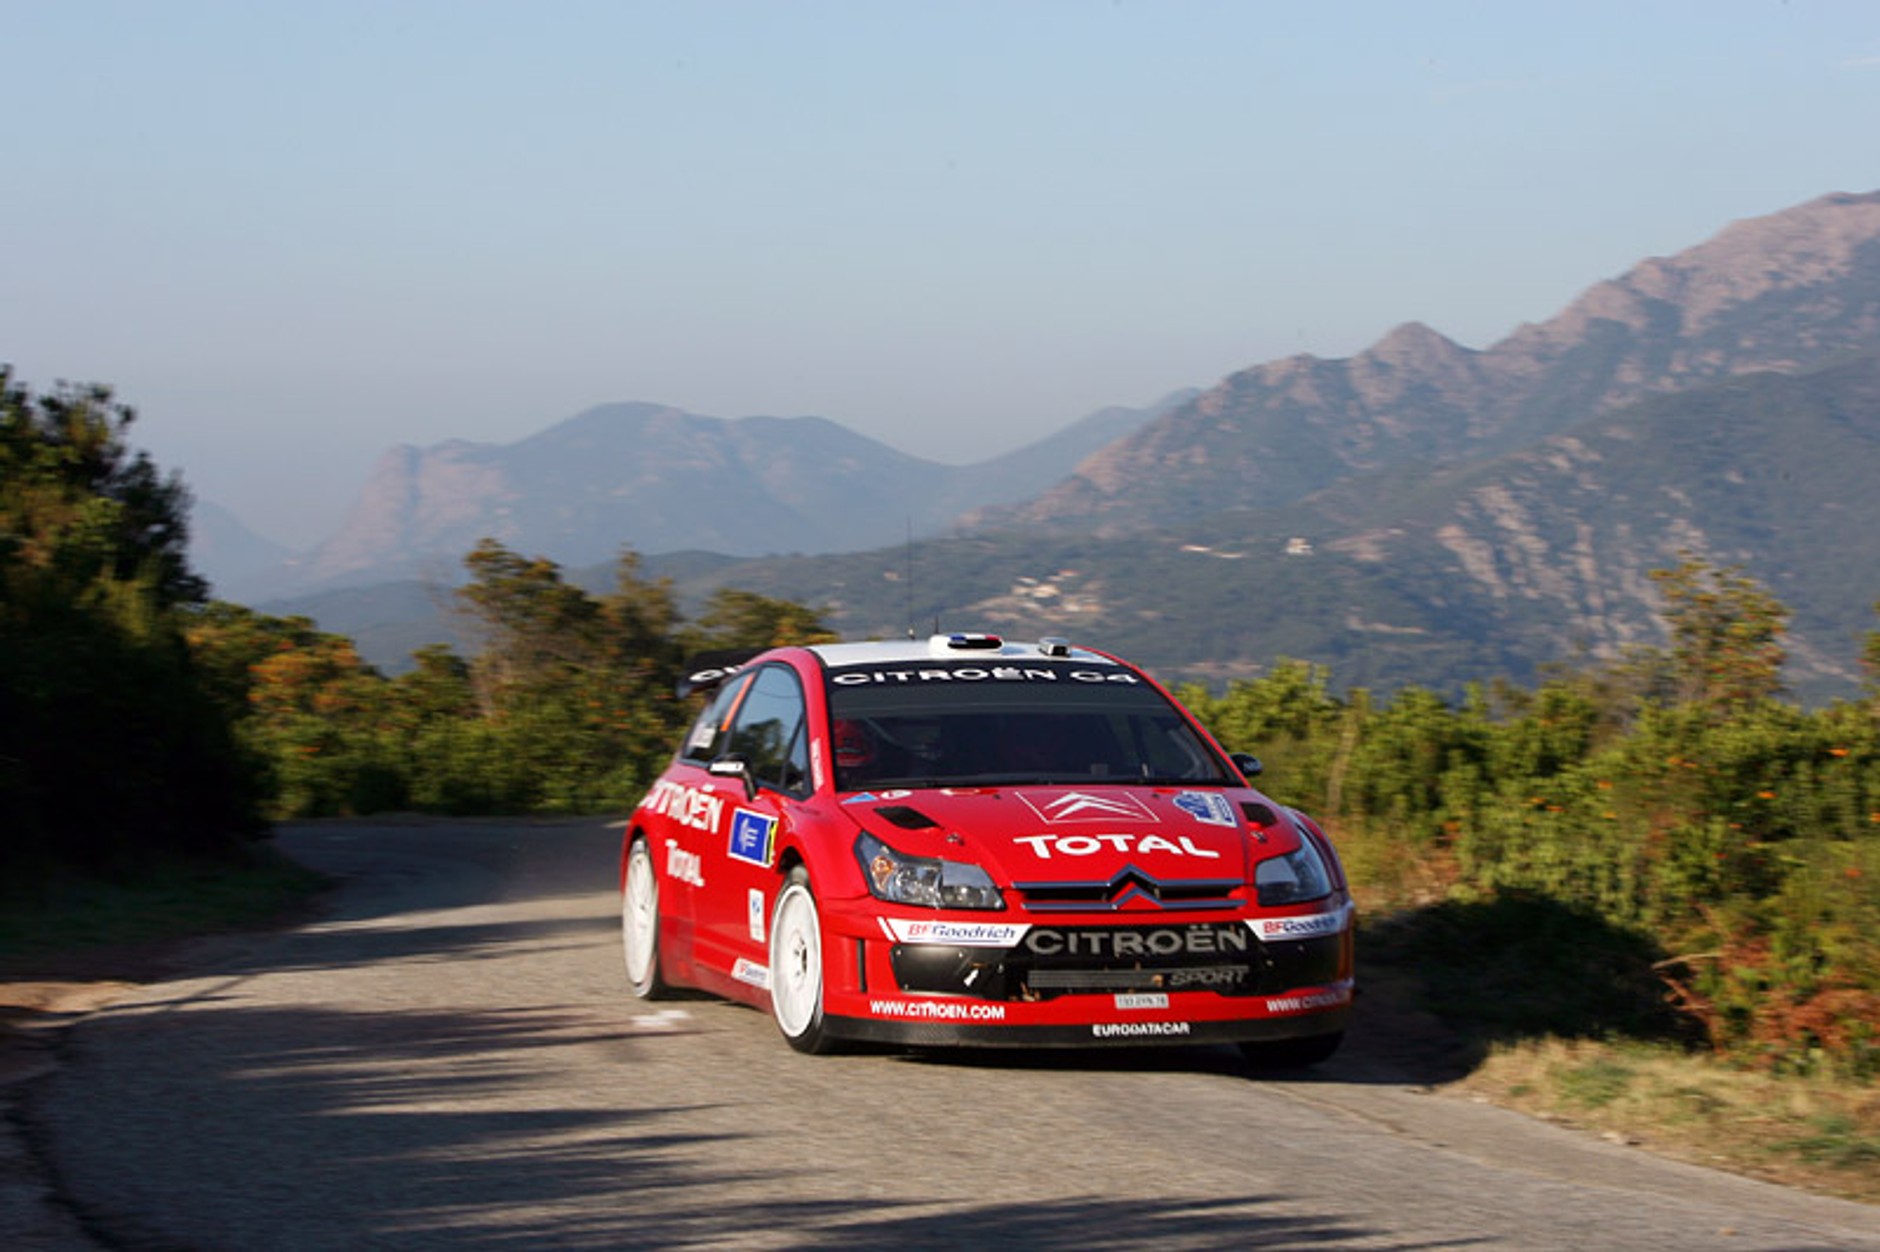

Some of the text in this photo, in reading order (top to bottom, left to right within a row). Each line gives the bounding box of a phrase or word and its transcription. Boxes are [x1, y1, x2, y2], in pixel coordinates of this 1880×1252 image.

[833, 666, 1138, 684] CITROËN C4
[637, 779, 724, 834] ITROËN
[1013, 833, 1220, 859] TOTAL
[907, 923, 1016, 939] BFGoodrich
[1025, 924, 1248, 956] CITROËN
[1169, 966, 1249, 986] SPORT
[870, 1000, 1005, 1019] WWW.CITROEN.COM
